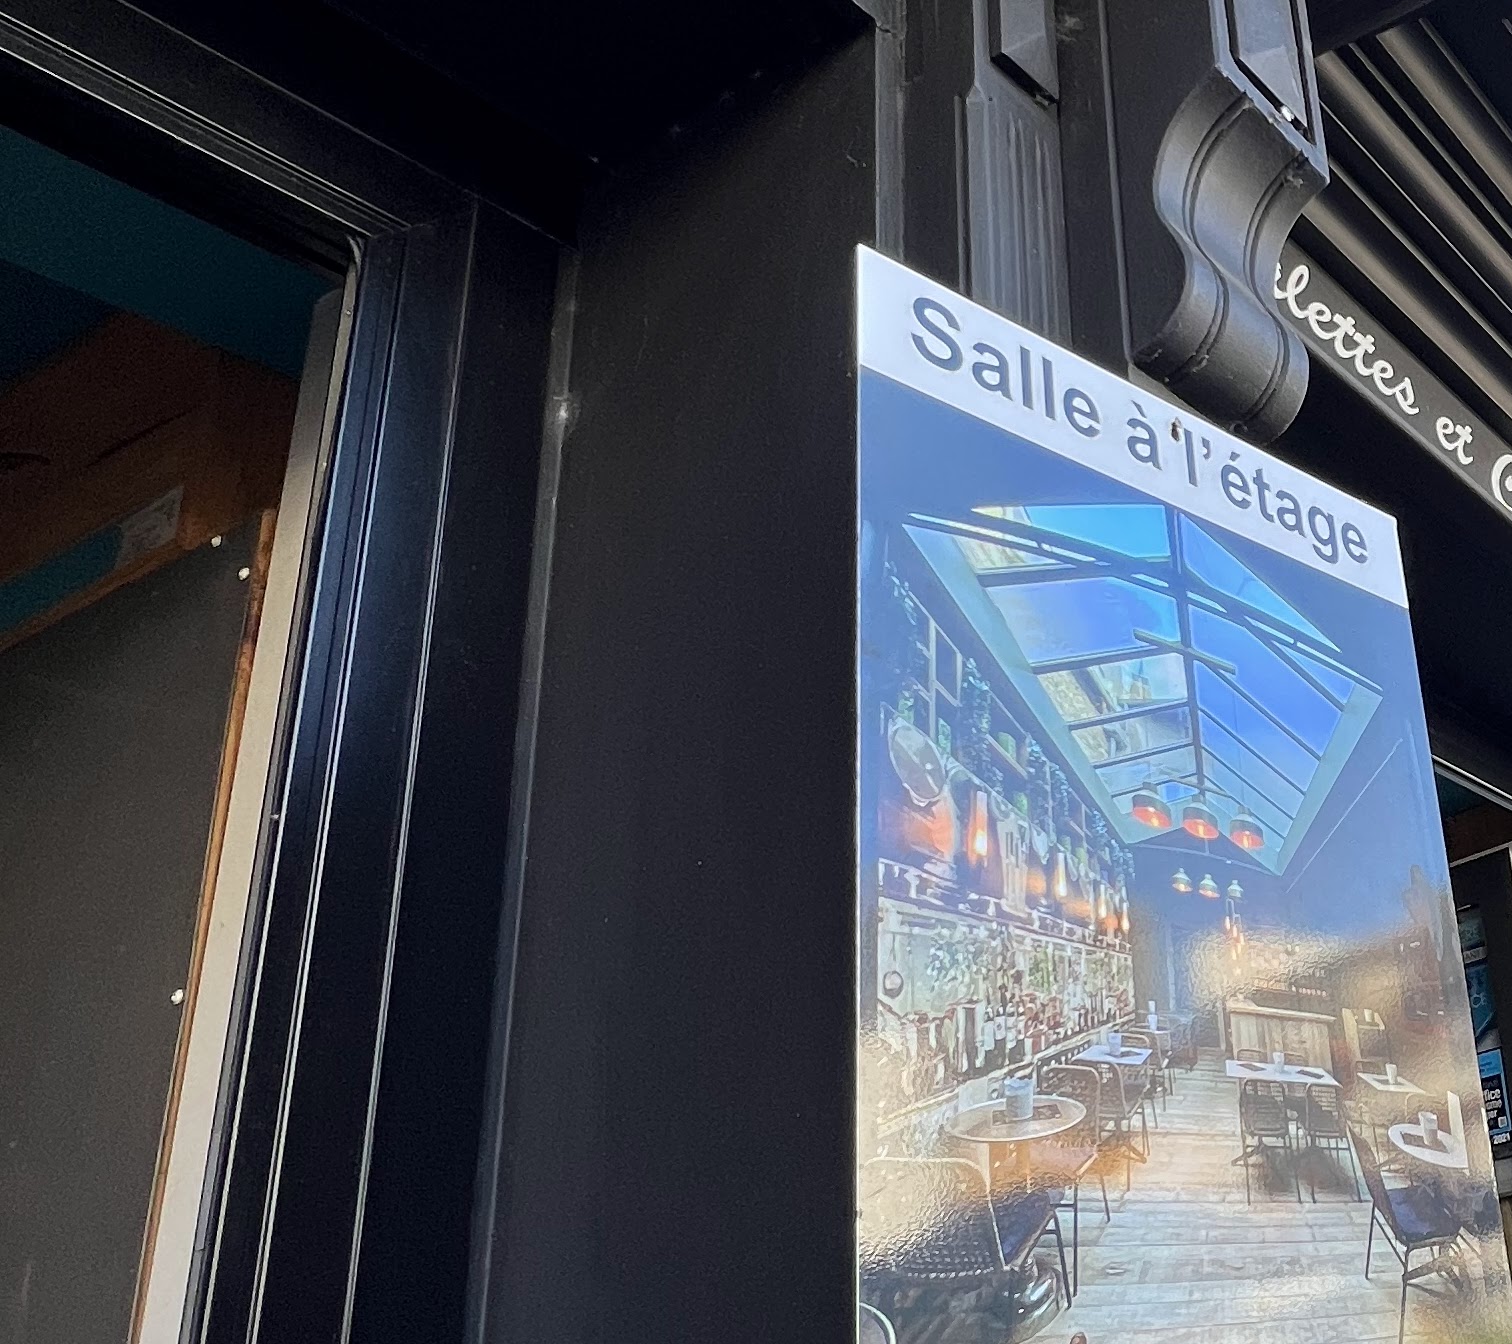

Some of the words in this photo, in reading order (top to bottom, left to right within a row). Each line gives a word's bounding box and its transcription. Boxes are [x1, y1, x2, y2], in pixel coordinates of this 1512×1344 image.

[911, 296, 1102, 438] Salle
[1126, 400, 1163, 471] à
[1273, 261, 1420, 415] lettes
[1436, 415, 1475, 465] et
